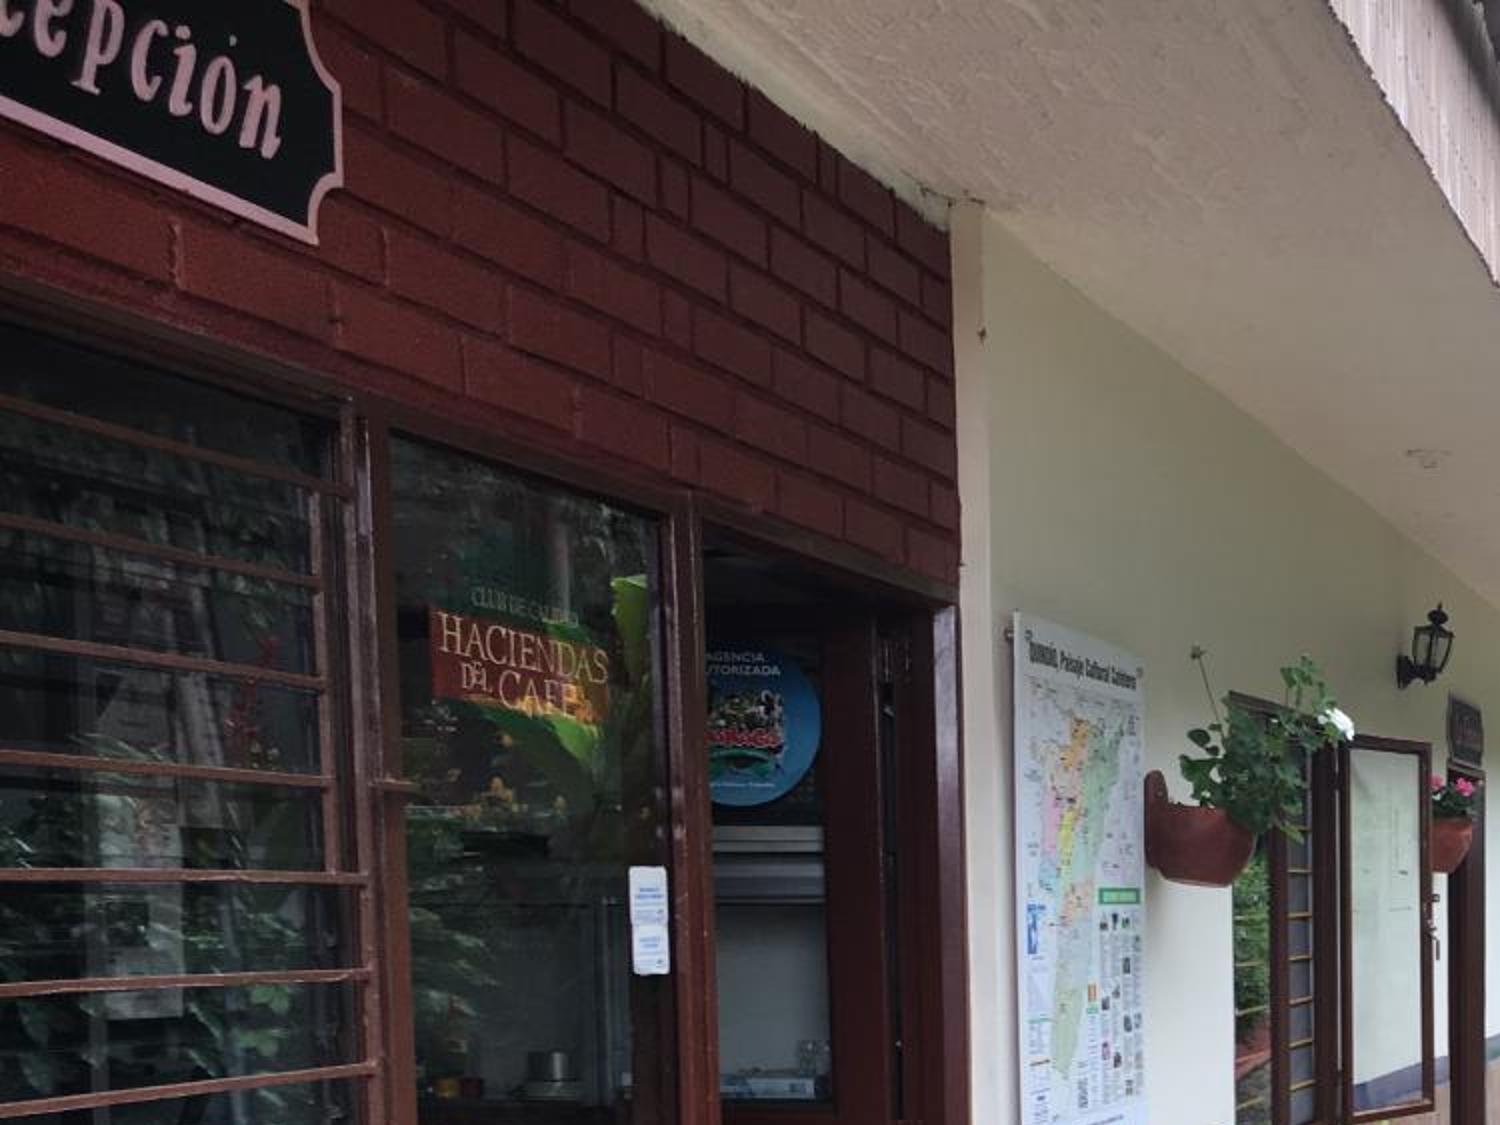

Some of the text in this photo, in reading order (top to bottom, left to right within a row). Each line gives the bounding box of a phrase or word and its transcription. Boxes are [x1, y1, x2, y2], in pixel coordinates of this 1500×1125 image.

[436, 611, 609, 684] HACIENDAS
[460, 660, 493, 693] DEL
[704, 664, 781, 676] UTORIZADA
